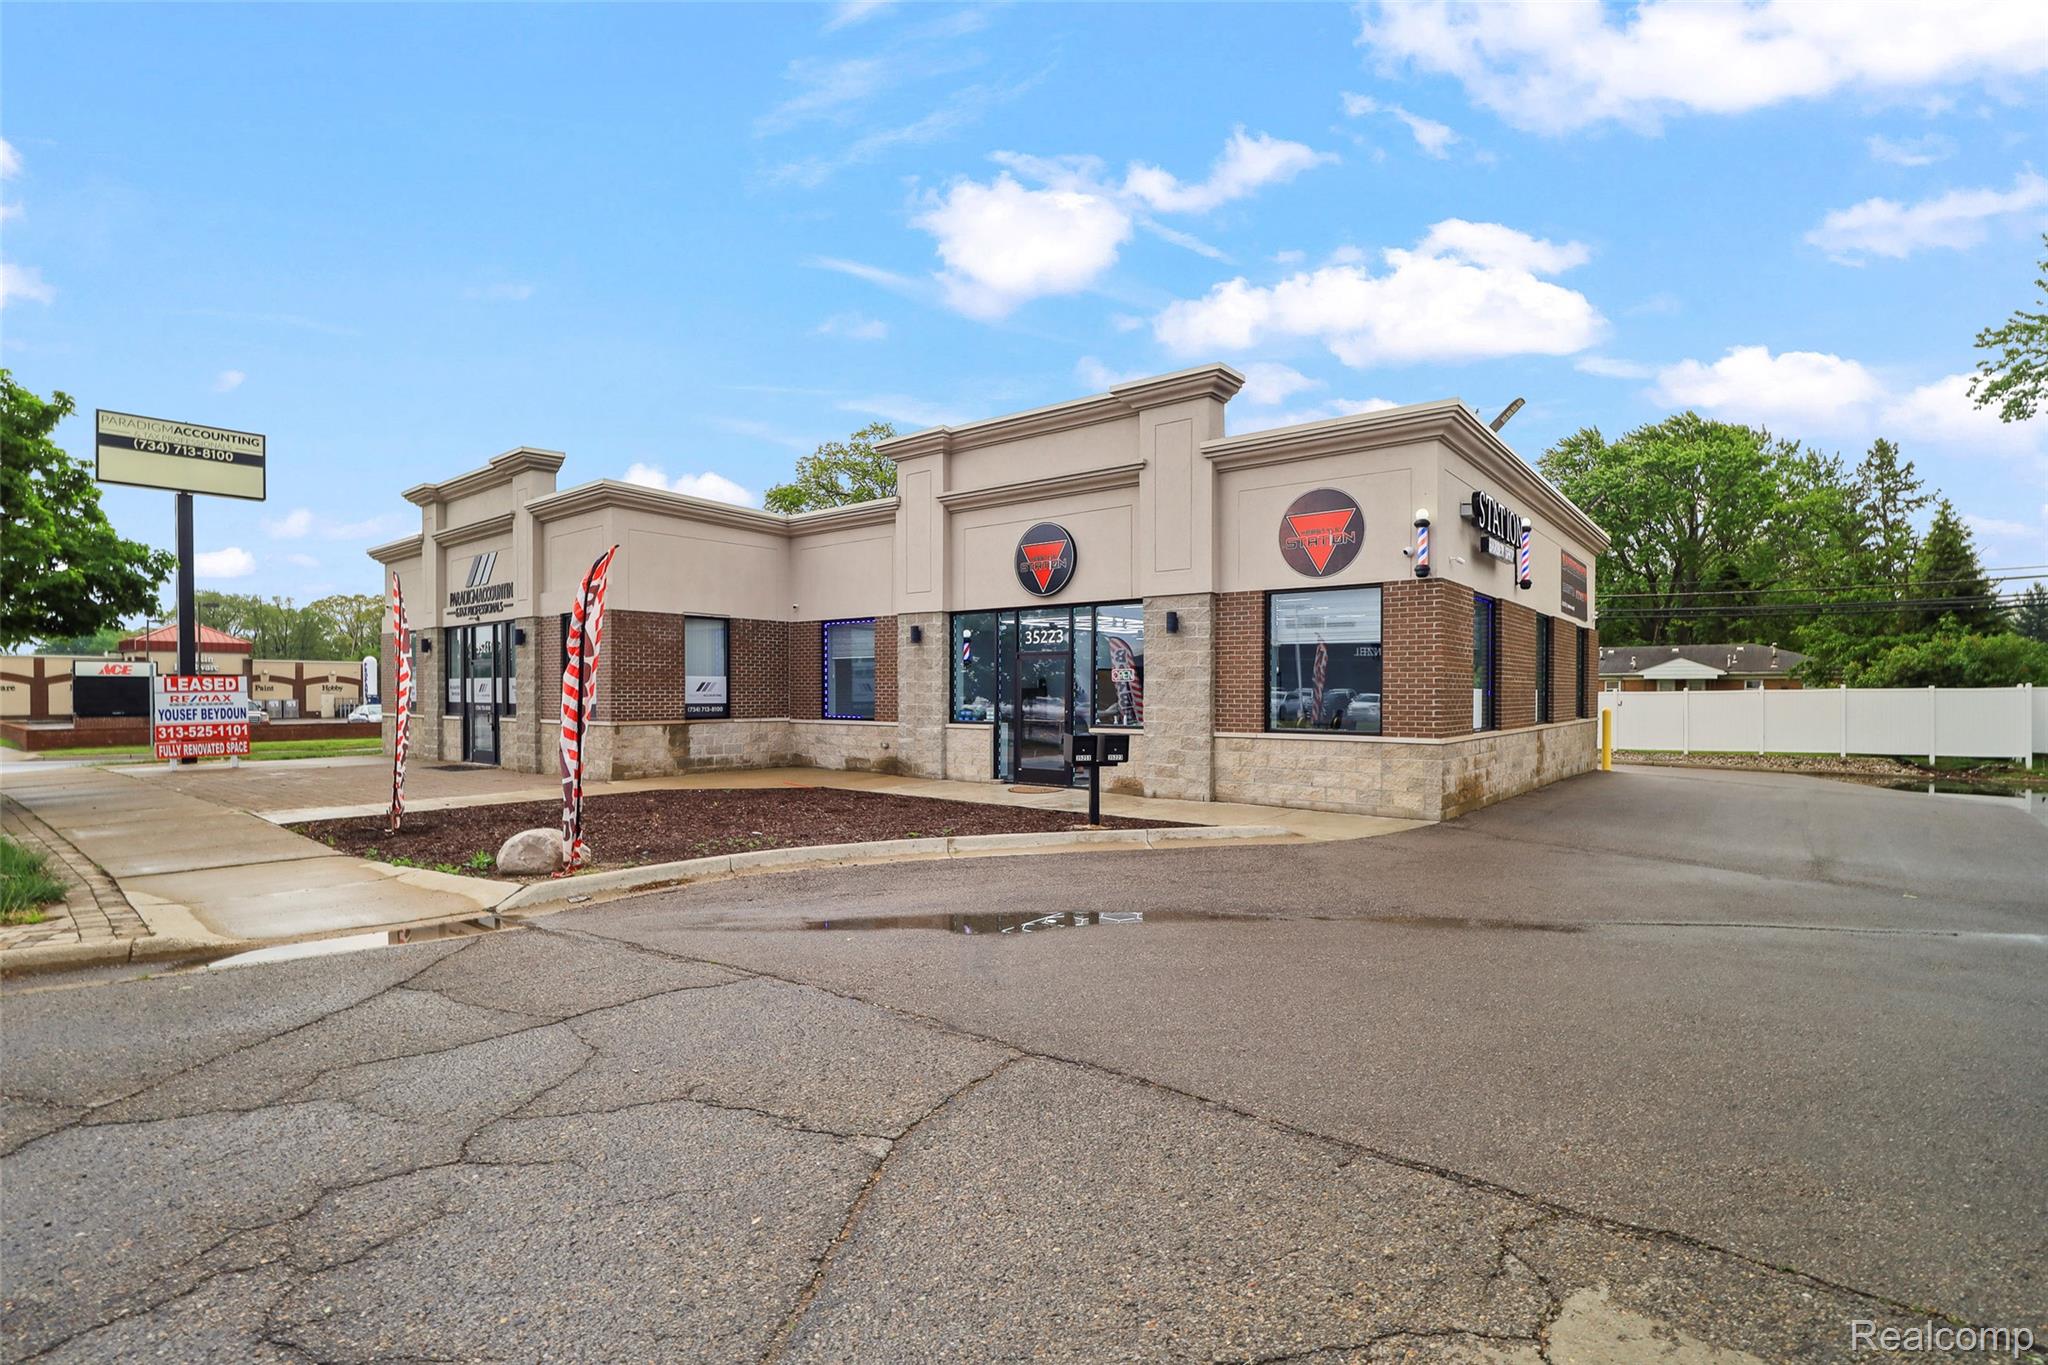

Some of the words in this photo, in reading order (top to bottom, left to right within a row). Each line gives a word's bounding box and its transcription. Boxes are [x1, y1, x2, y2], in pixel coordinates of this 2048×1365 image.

[133, 438, 170, 454] (734)
[173, 444, 234, 462] 713-8100
[161, 434, 232, 451] PROFESSIONALS
[1479, 490, 1522, 549] STATION
[1285, 531, 1356, 550] STATION
[1025, 629, 1064, 645] 35223
[97, 664, 133, 675] ACE
[166, 677, 237, 691] LEASED
[254, 684, 274, 692] Paint
[321, 684, 343, 692] Hobby
[170, 694, 232, 703] RE/MAX
[158, 708, 198, 721] YOUSEF
[201, 707, 247, 720] BEYDOUN
[158, 724, 248, 739] 313-525-1101
[159, 742, 182, 757] FULLY
[183, 742, 225, 756] RENOVATED
[226, 741, 248, 753] SPACE
